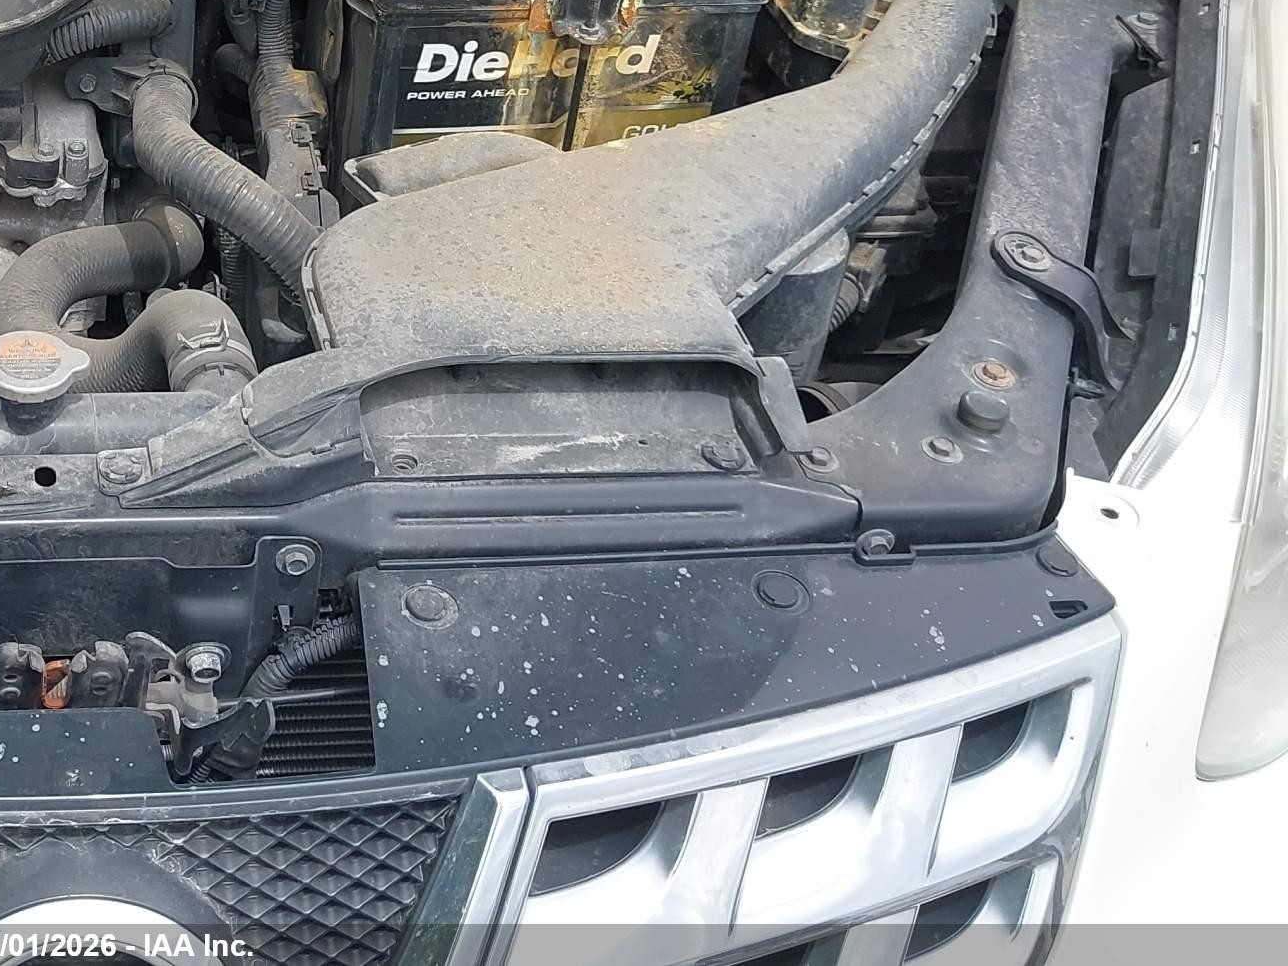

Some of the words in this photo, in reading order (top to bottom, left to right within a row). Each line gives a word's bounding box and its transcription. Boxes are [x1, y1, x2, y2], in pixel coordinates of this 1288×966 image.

[413, 34, 662, 83] DieHard
[406, 90, 466, 101] POWER
[471, 88, 530, 99] AHEAD
[621, 123, 676, 140] GO
